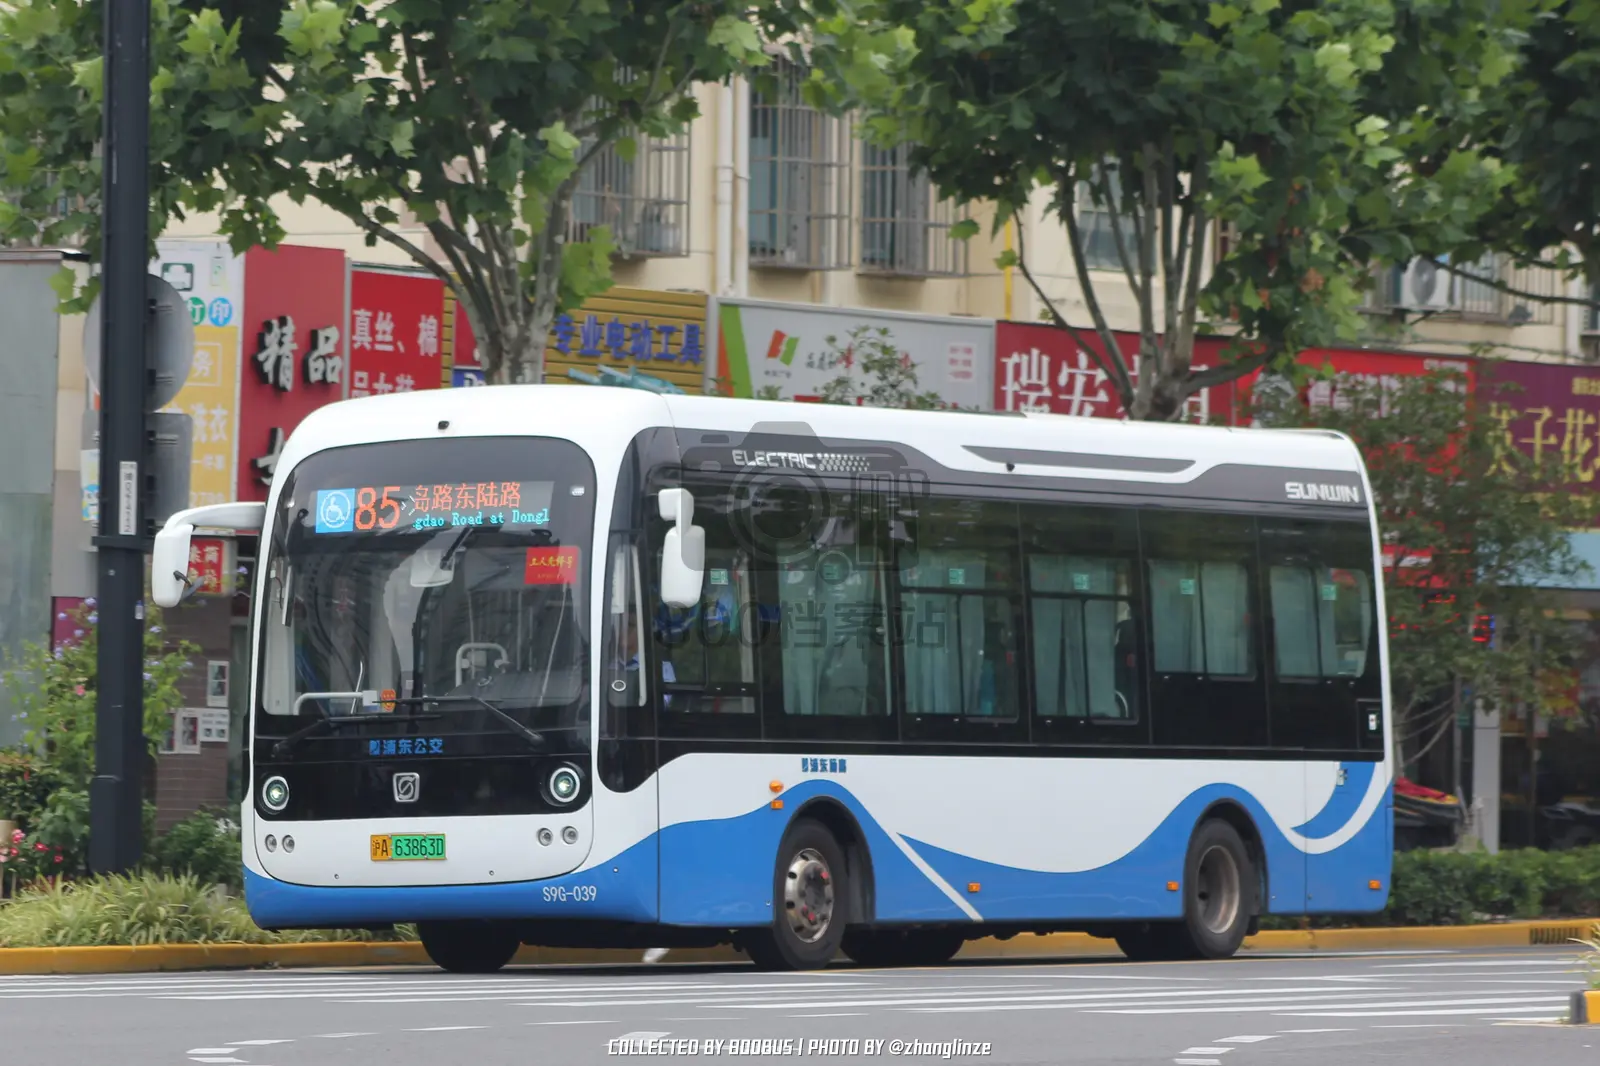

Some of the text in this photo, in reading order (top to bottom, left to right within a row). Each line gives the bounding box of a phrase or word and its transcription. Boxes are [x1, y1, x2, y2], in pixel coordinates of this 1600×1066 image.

[552, 312, 703, 365] 专业电动工具
[252, 314, 342, 392] 精品
[732, 449, 816, 469] ELECTRIC
[1284, 481, 1360, 504] SUNWIN
[355, 485, 401, 530] 85
[451, 511, 483, 526] Road
[489, 512, 505, 525] at
[383, 738, 443, 755] 浦东公交
[395, 837, 444, 857] 63863D
[542, 885, 597, 902] S9G-039
